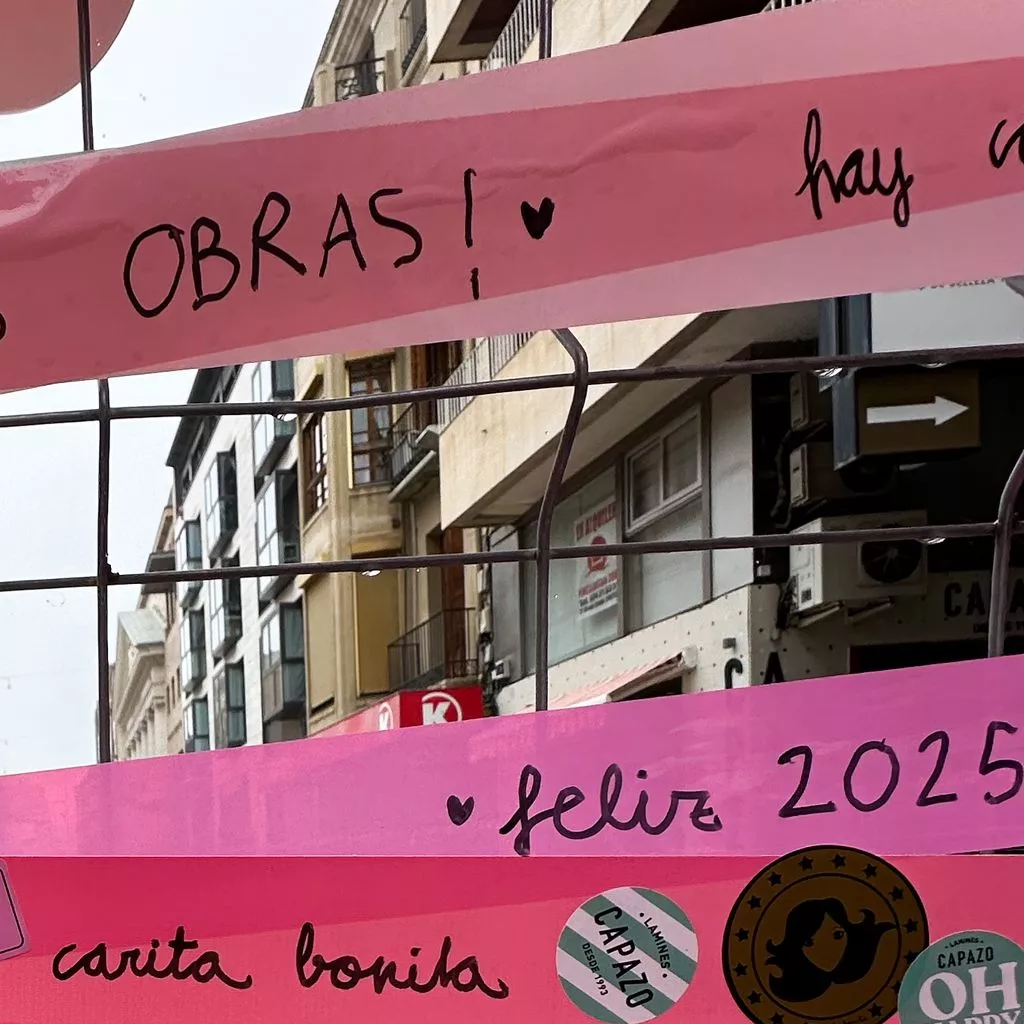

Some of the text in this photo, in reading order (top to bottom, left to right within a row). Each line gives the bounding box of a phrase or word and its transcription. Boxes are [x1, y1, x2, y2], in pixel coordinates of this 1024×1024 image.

[796, 109, 914, 227] hay
[124, 168, 480, 318] OBRAS!
[500, 722, 1024, 857] feliz 2025
[52, 926, 252, 990] carita
[582, 942, 609, 996] DESDE 1993
[594, 906, 654, 1008] CAPAZO
[644, 917, 671, 969] LAMINES
[938, 946, 994, 969] CAPAZO
[919, 962, 1021, 1021] OH
